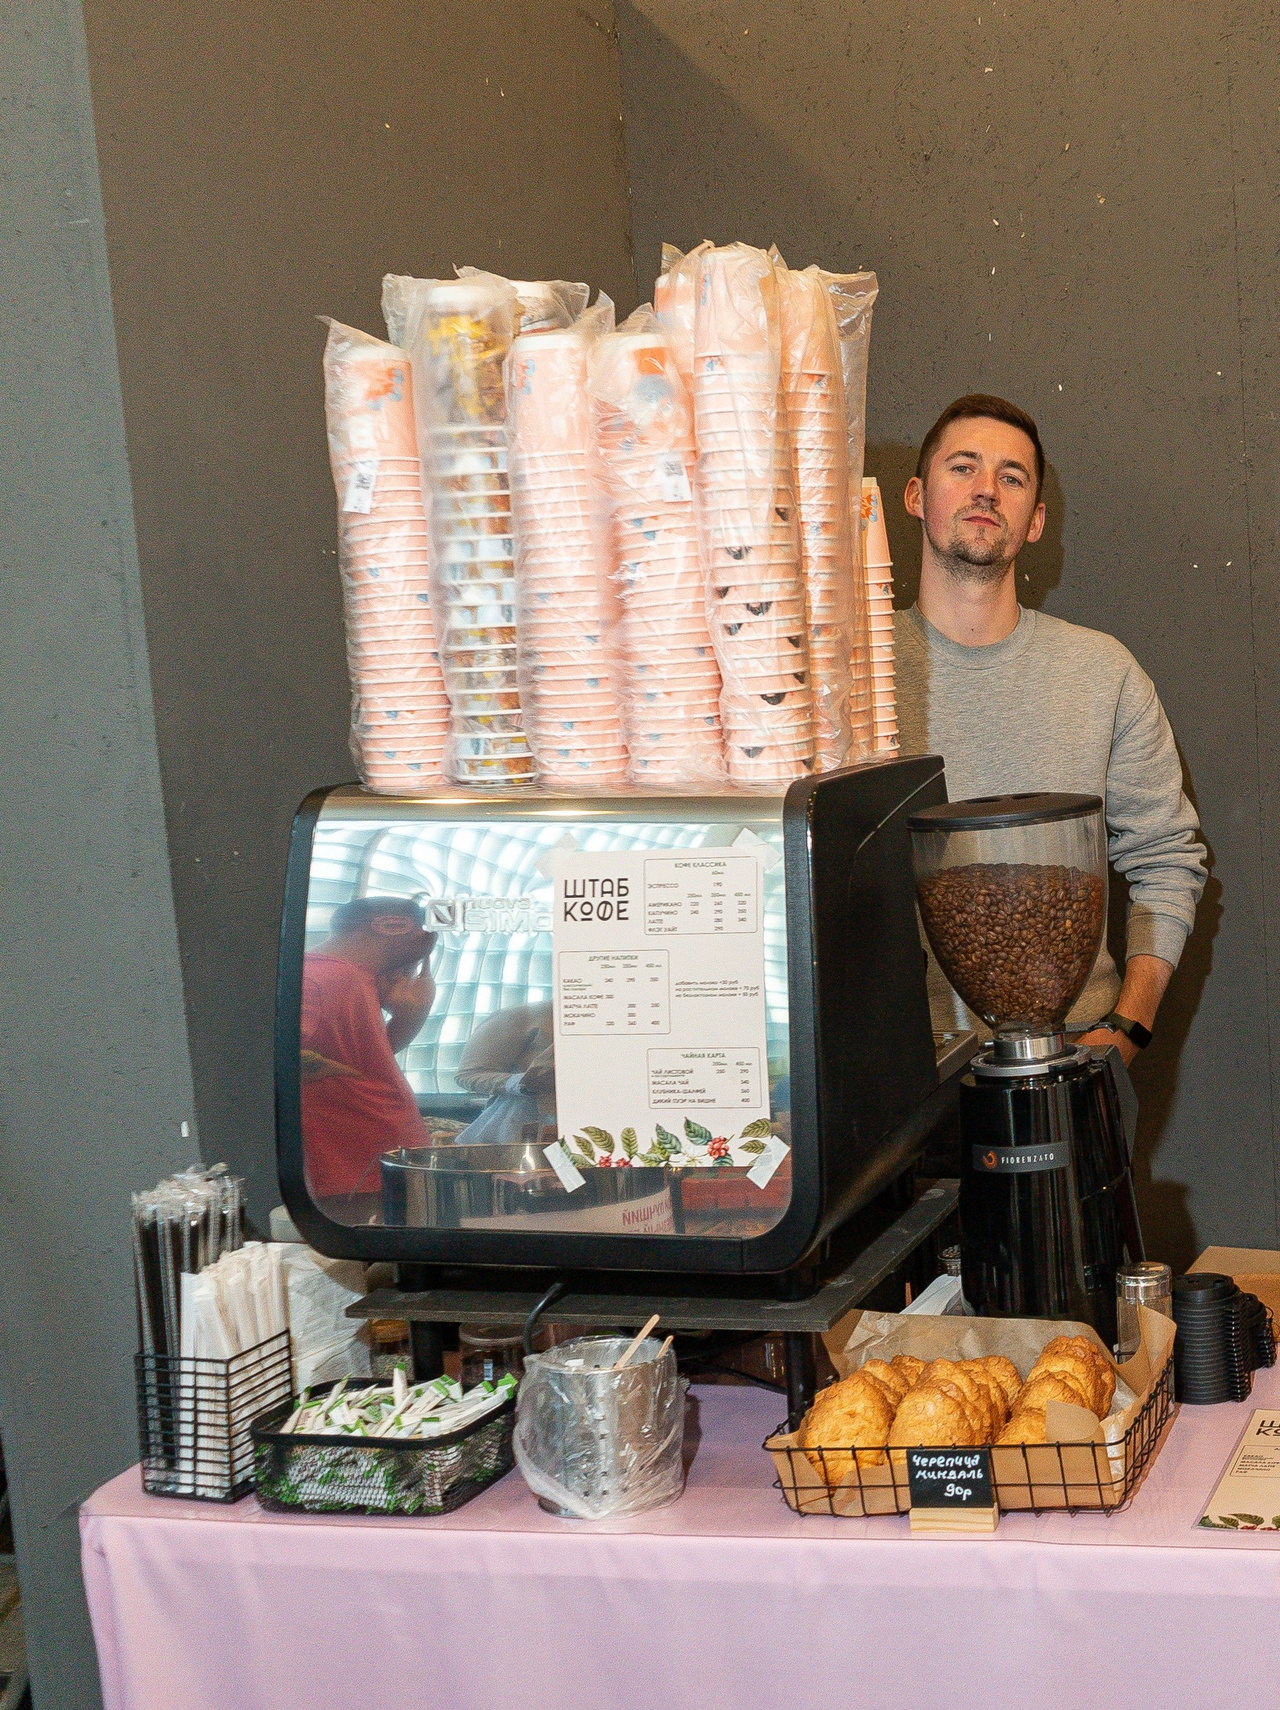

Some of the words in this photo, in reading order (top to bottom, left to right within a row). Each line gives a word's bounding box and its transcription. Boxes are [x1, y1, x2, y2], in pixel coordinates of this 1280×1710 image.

[564, 878, 630, 899] ШТАБ
[563, 900, 630, 922] КОФЕ
[1002, 1153, 1054, 1164] FIORENZATO
[912, 1454, 980, 1469] черепица
[915, 1468, 984, 1480] миндаль
[944, 1483, 972, 1501] 90р
